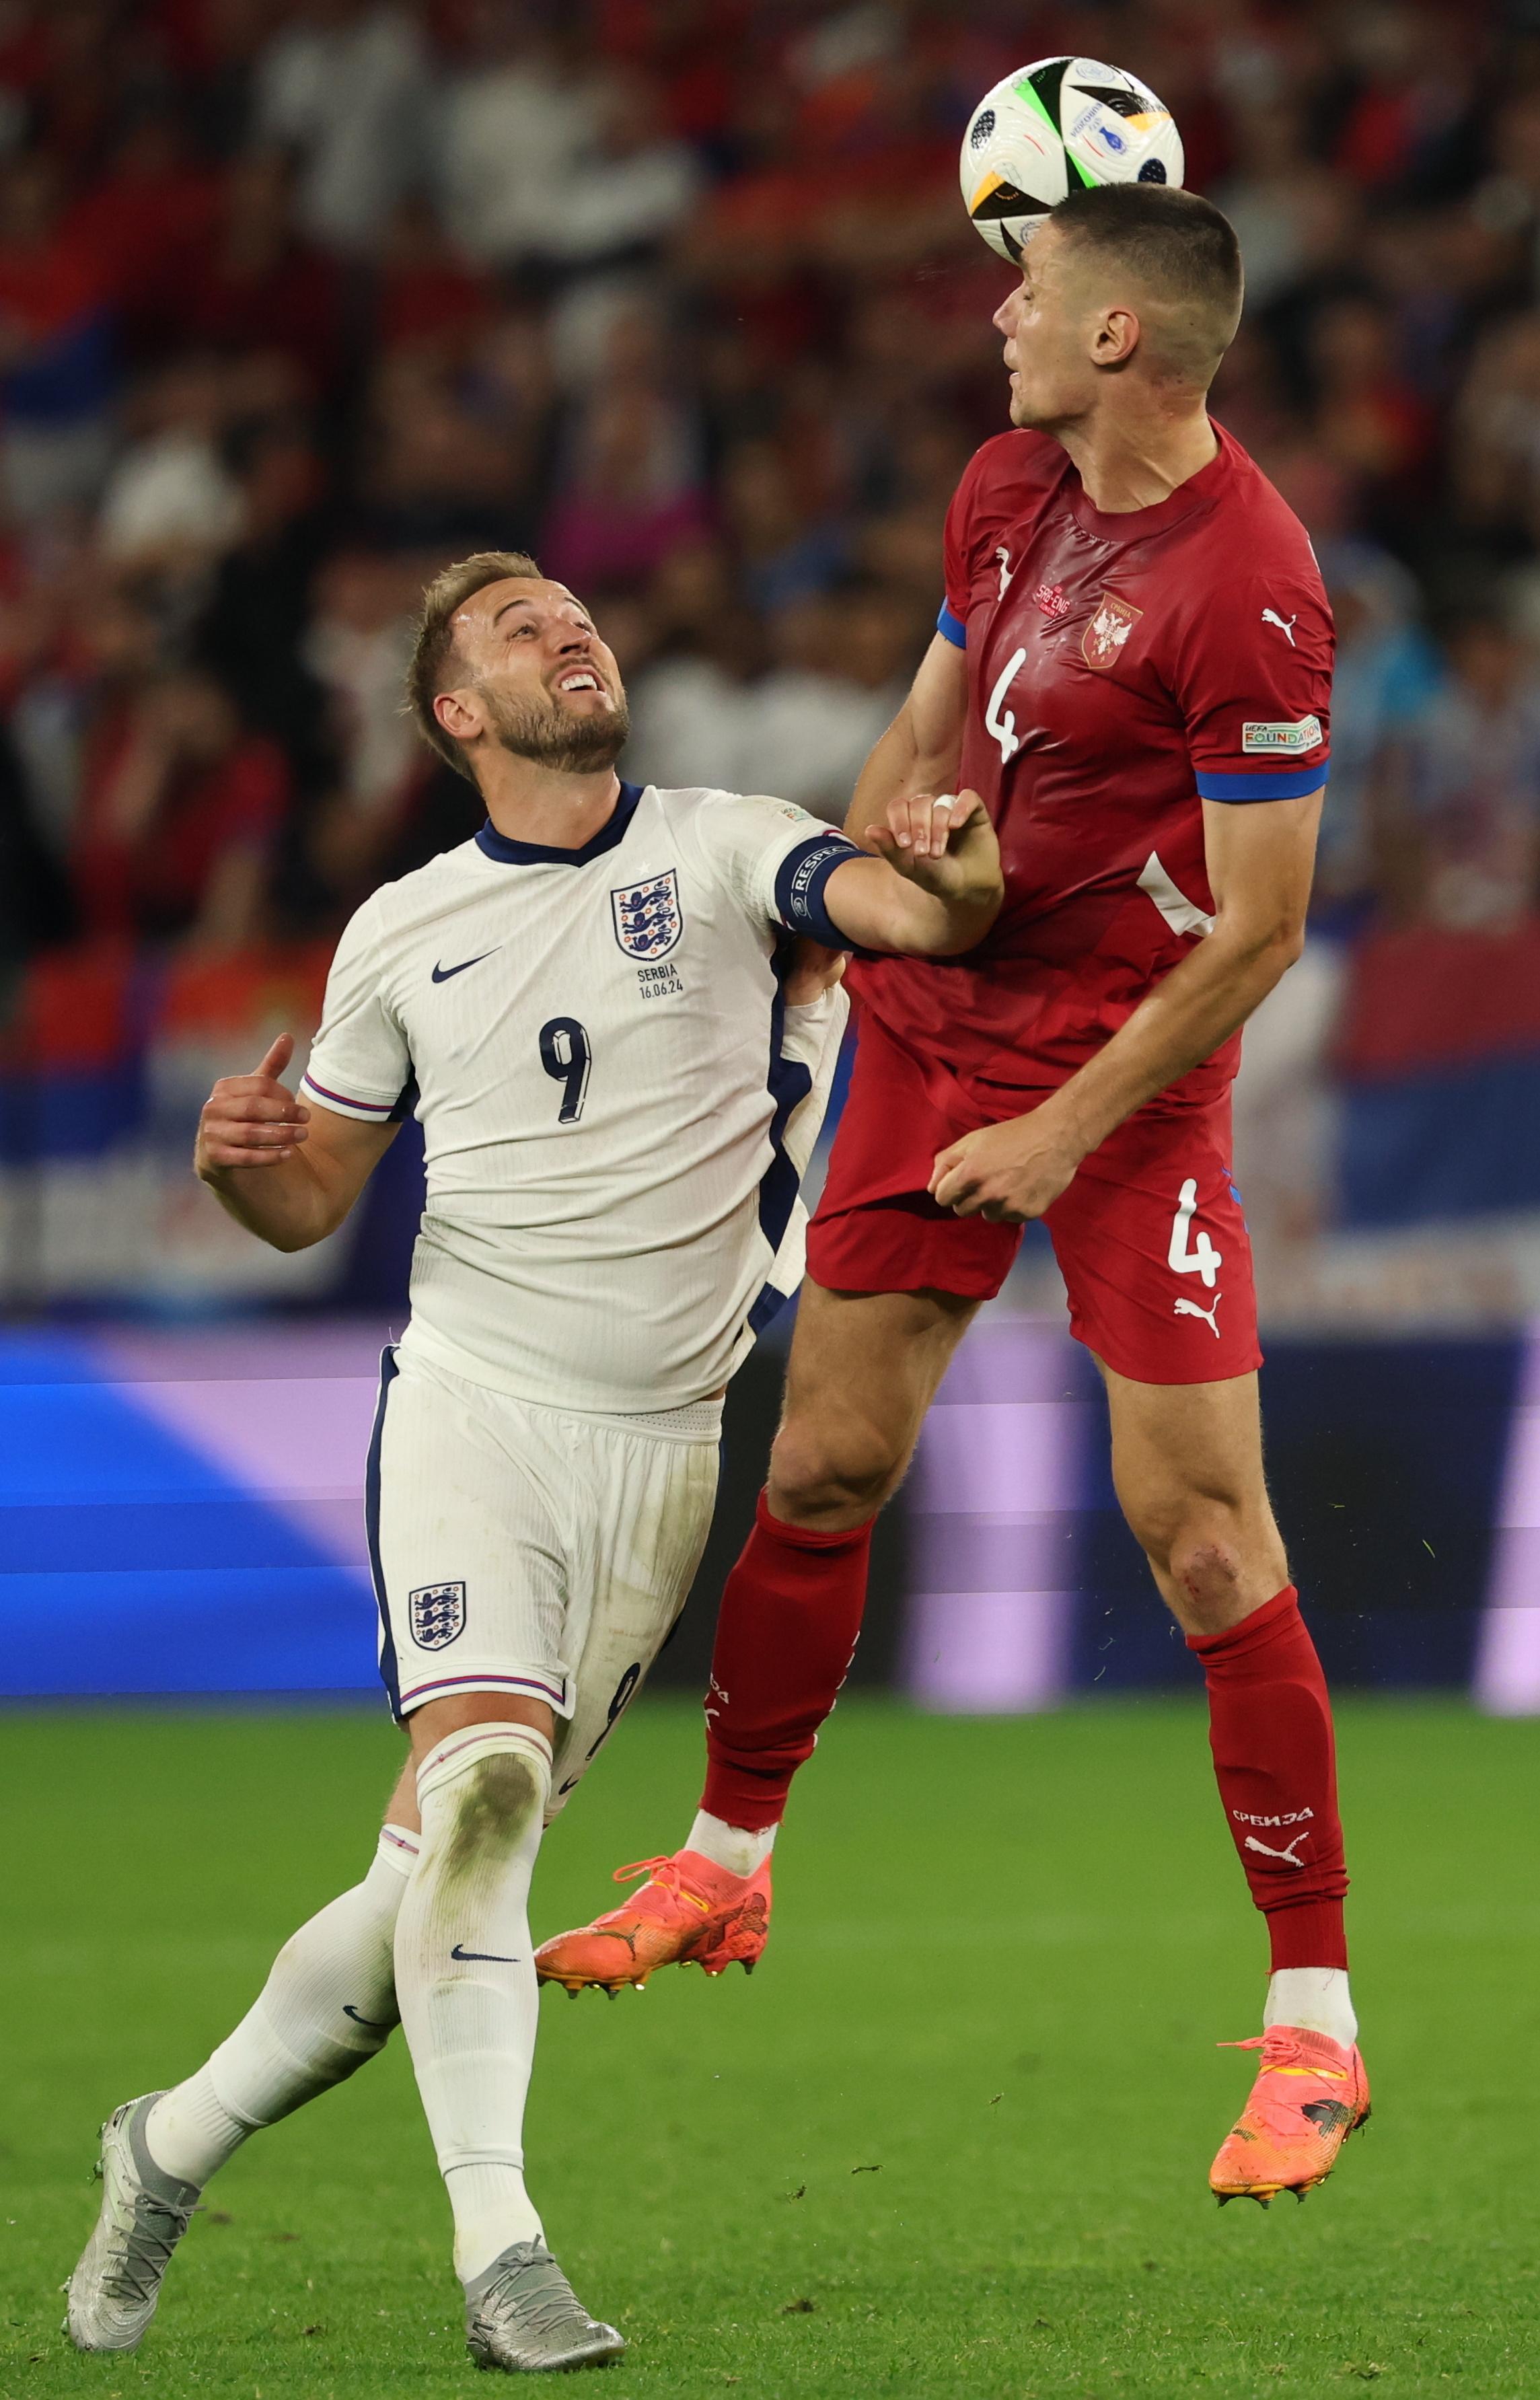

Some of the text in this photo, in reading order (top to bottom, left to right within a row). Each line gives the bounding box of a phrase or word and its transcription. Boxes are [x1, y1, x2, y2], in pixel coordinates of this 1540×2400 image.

[1036, 584, 1070, 614] SRB-ENG
[985, 647, 1027, 764] 4
[1245, 722, 1319, 743] FOUNDATION
[795, 847, 852, 891] RESPEC
[637, 963, 678, 982] SERBIA
[639, 979, 684, 999] 16.06.24
[539, 1017, 592, 1124] 9
[1168, 1177, 1222, 1288] 4
